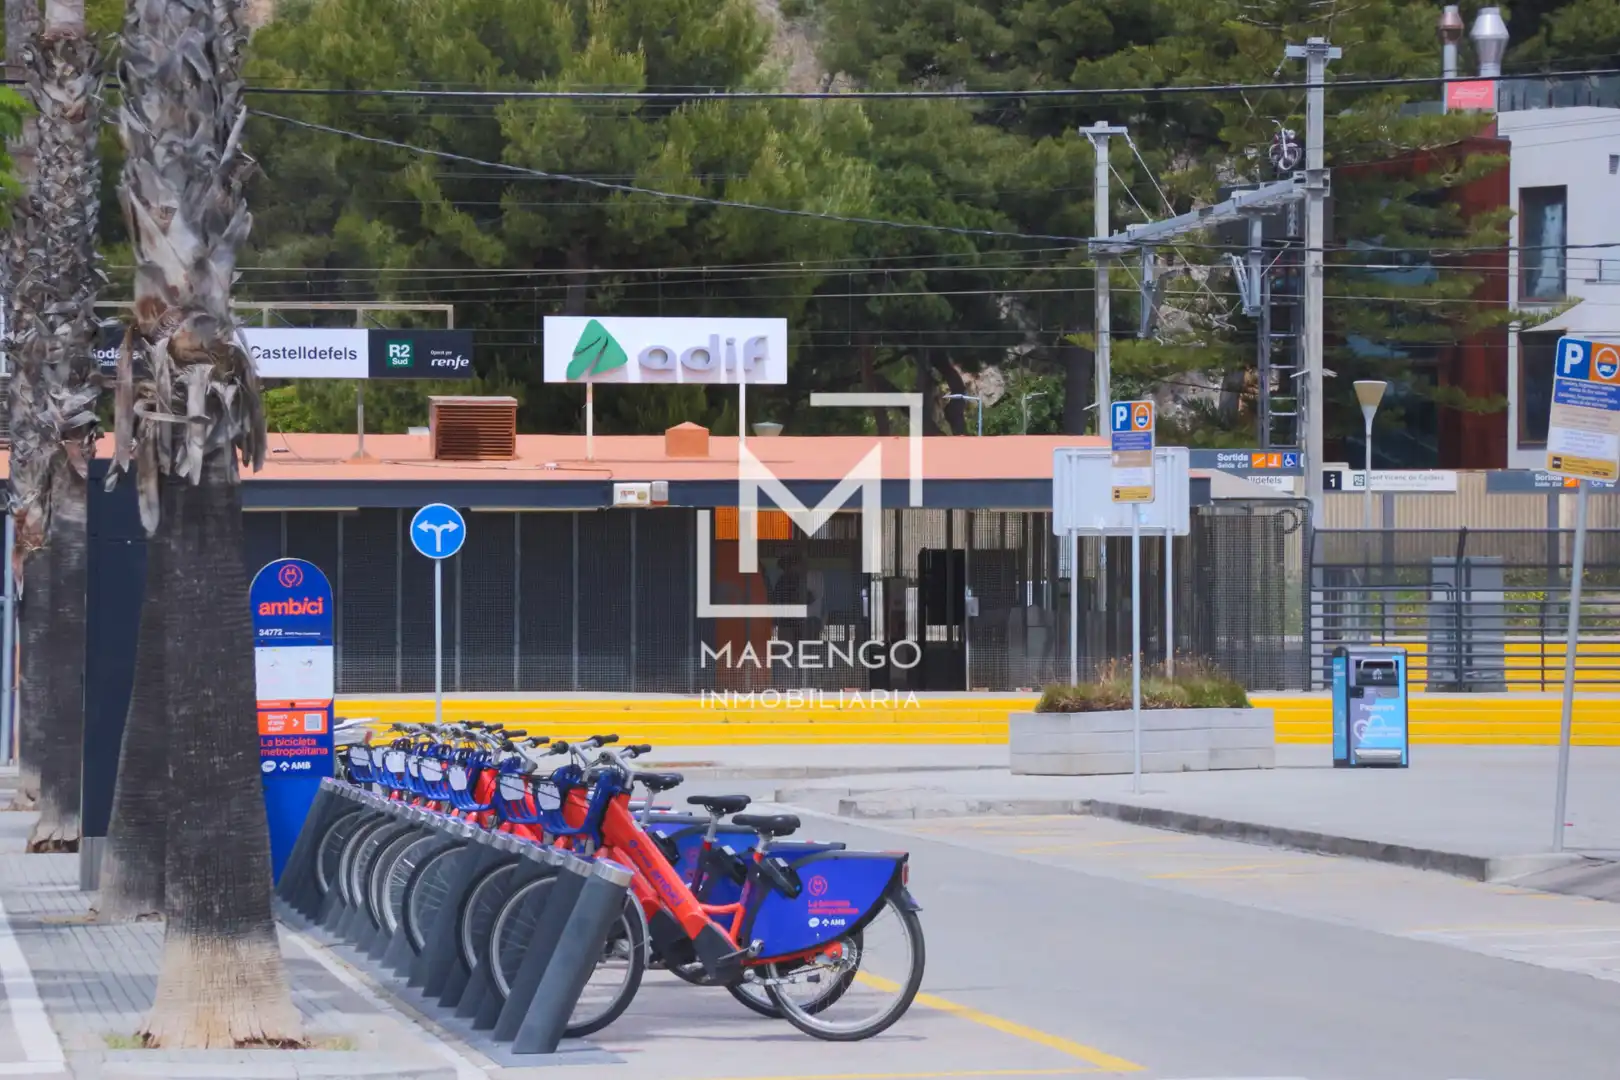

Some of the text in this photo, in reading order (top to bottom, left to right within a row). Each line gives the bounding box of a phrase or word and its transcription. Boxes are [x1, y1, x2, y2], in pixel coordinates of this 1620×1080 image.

[251, 345, 358, 360] Castelldefels
[389, 344, 410, 357] R2
[638, 334, 768, 371] adif
[392, 357, 409, 365] Sud
[431, 354, 470, 370] renfe
[1563, 343, 1584, 374] P
[1115, 406, 1128, 430] P
[1216, 452, 1249, 461] Sortida
[259, 597, 324, 616] ambici
[259, 628, 283, 637] 34772
[260, 737, 273, 747] La
[290, 761, 312, 770] AMB
